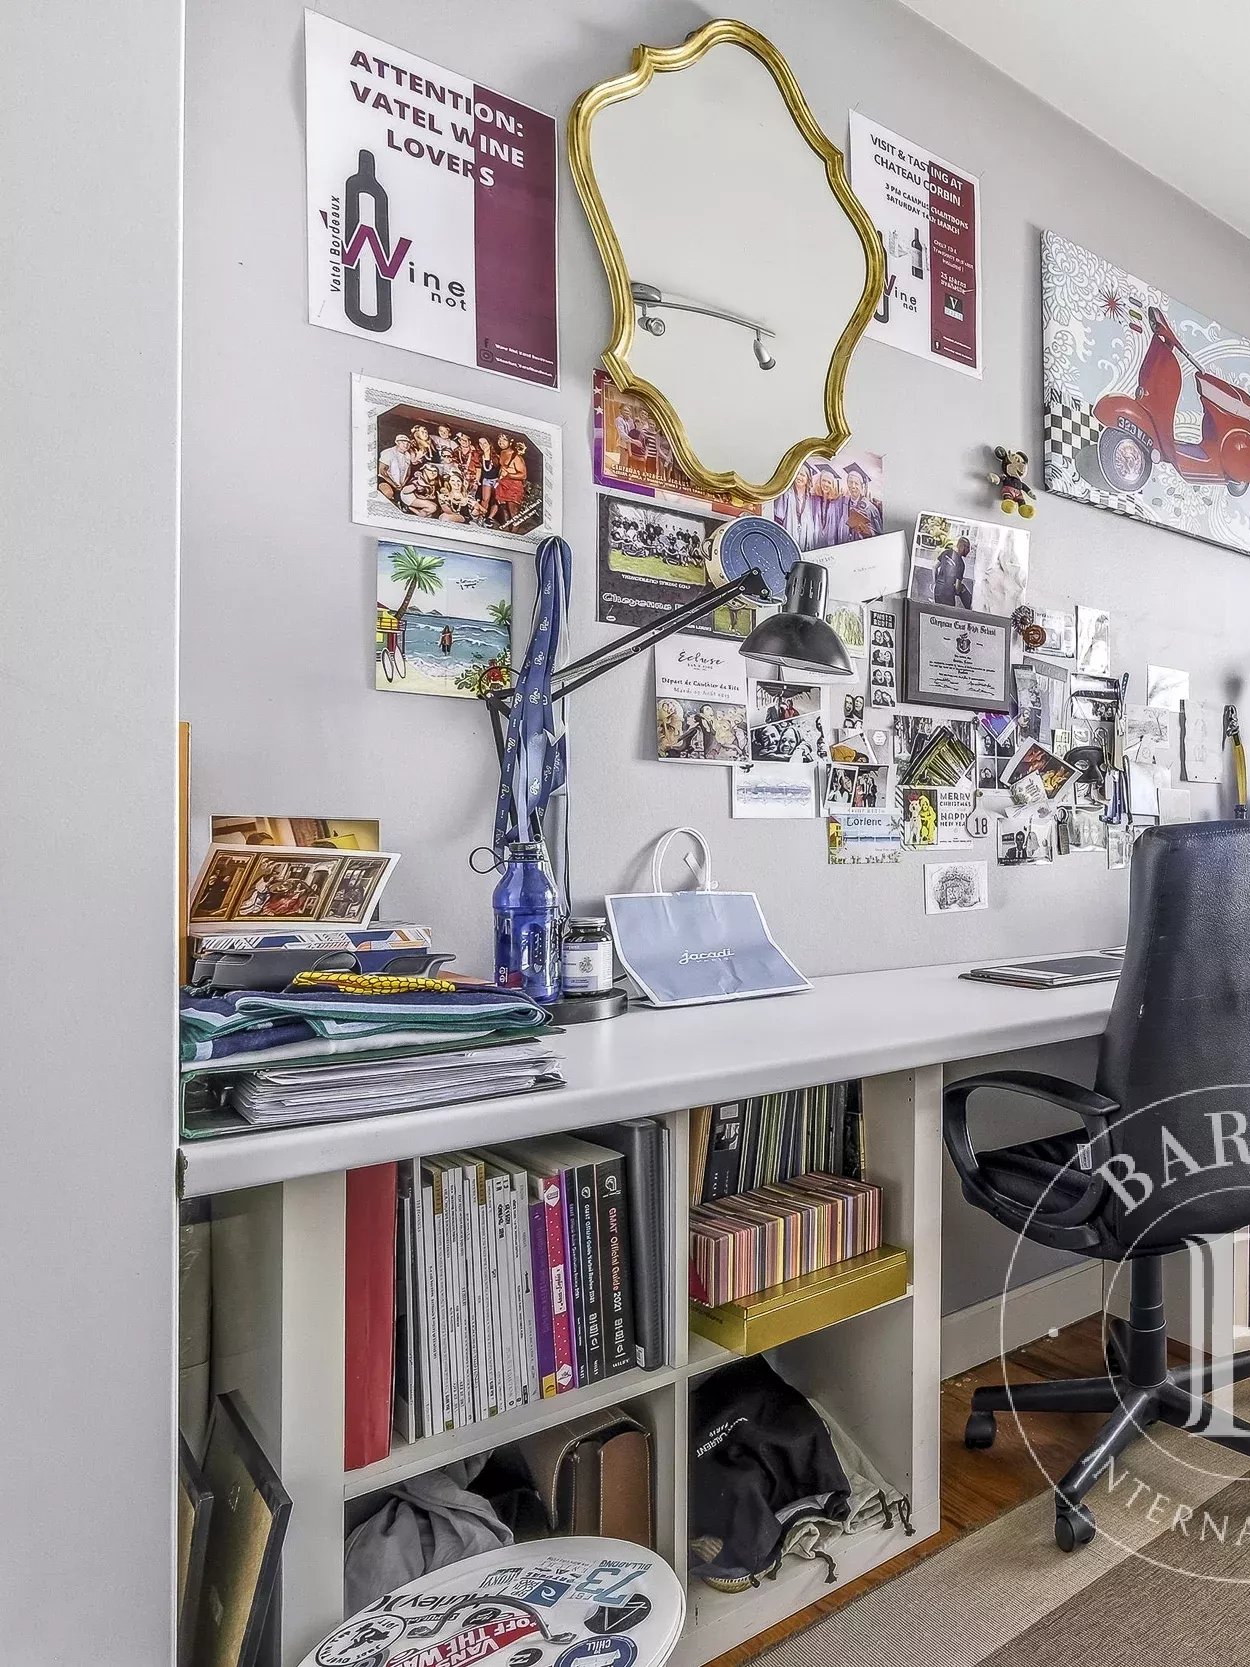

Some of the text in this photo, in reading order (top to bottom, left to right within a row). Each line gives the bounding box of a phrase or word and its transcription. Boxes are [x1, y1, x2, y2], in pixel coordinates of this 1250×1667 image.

[350, 50, 524, 138] ATTENTION:
[350, 80, 524, 169] VATEL WINE
[387, 129, 496, 188] LOVERS
[870, 133, 963, 191] VISIT & TASTING AT
[874, 154, 961, 207] CHATEAU CORBIN
[886, 194, 921, 215] SATURDAY
[329, 195, 341, 294] Vatel Bordeaux
[431, 291, 468, 312] not
[903, 302, 918, 313] not
[939, 792, 971, 801] MERRY
[974, 817, 988, 835] 18
[679, 948, 735, 965] jacadi
[608, 1207, 619, 1234] GMAT
[610, 1236, 620, 1265] Official
[612, 1265, 620, 1291] Guide
[613, 1291, 622, 1313] 2021
[575, 1567, 647, 1606] 73
[445, 1626, 491, 1653] THE
[586, 1639, 612, 1651] CHILL
